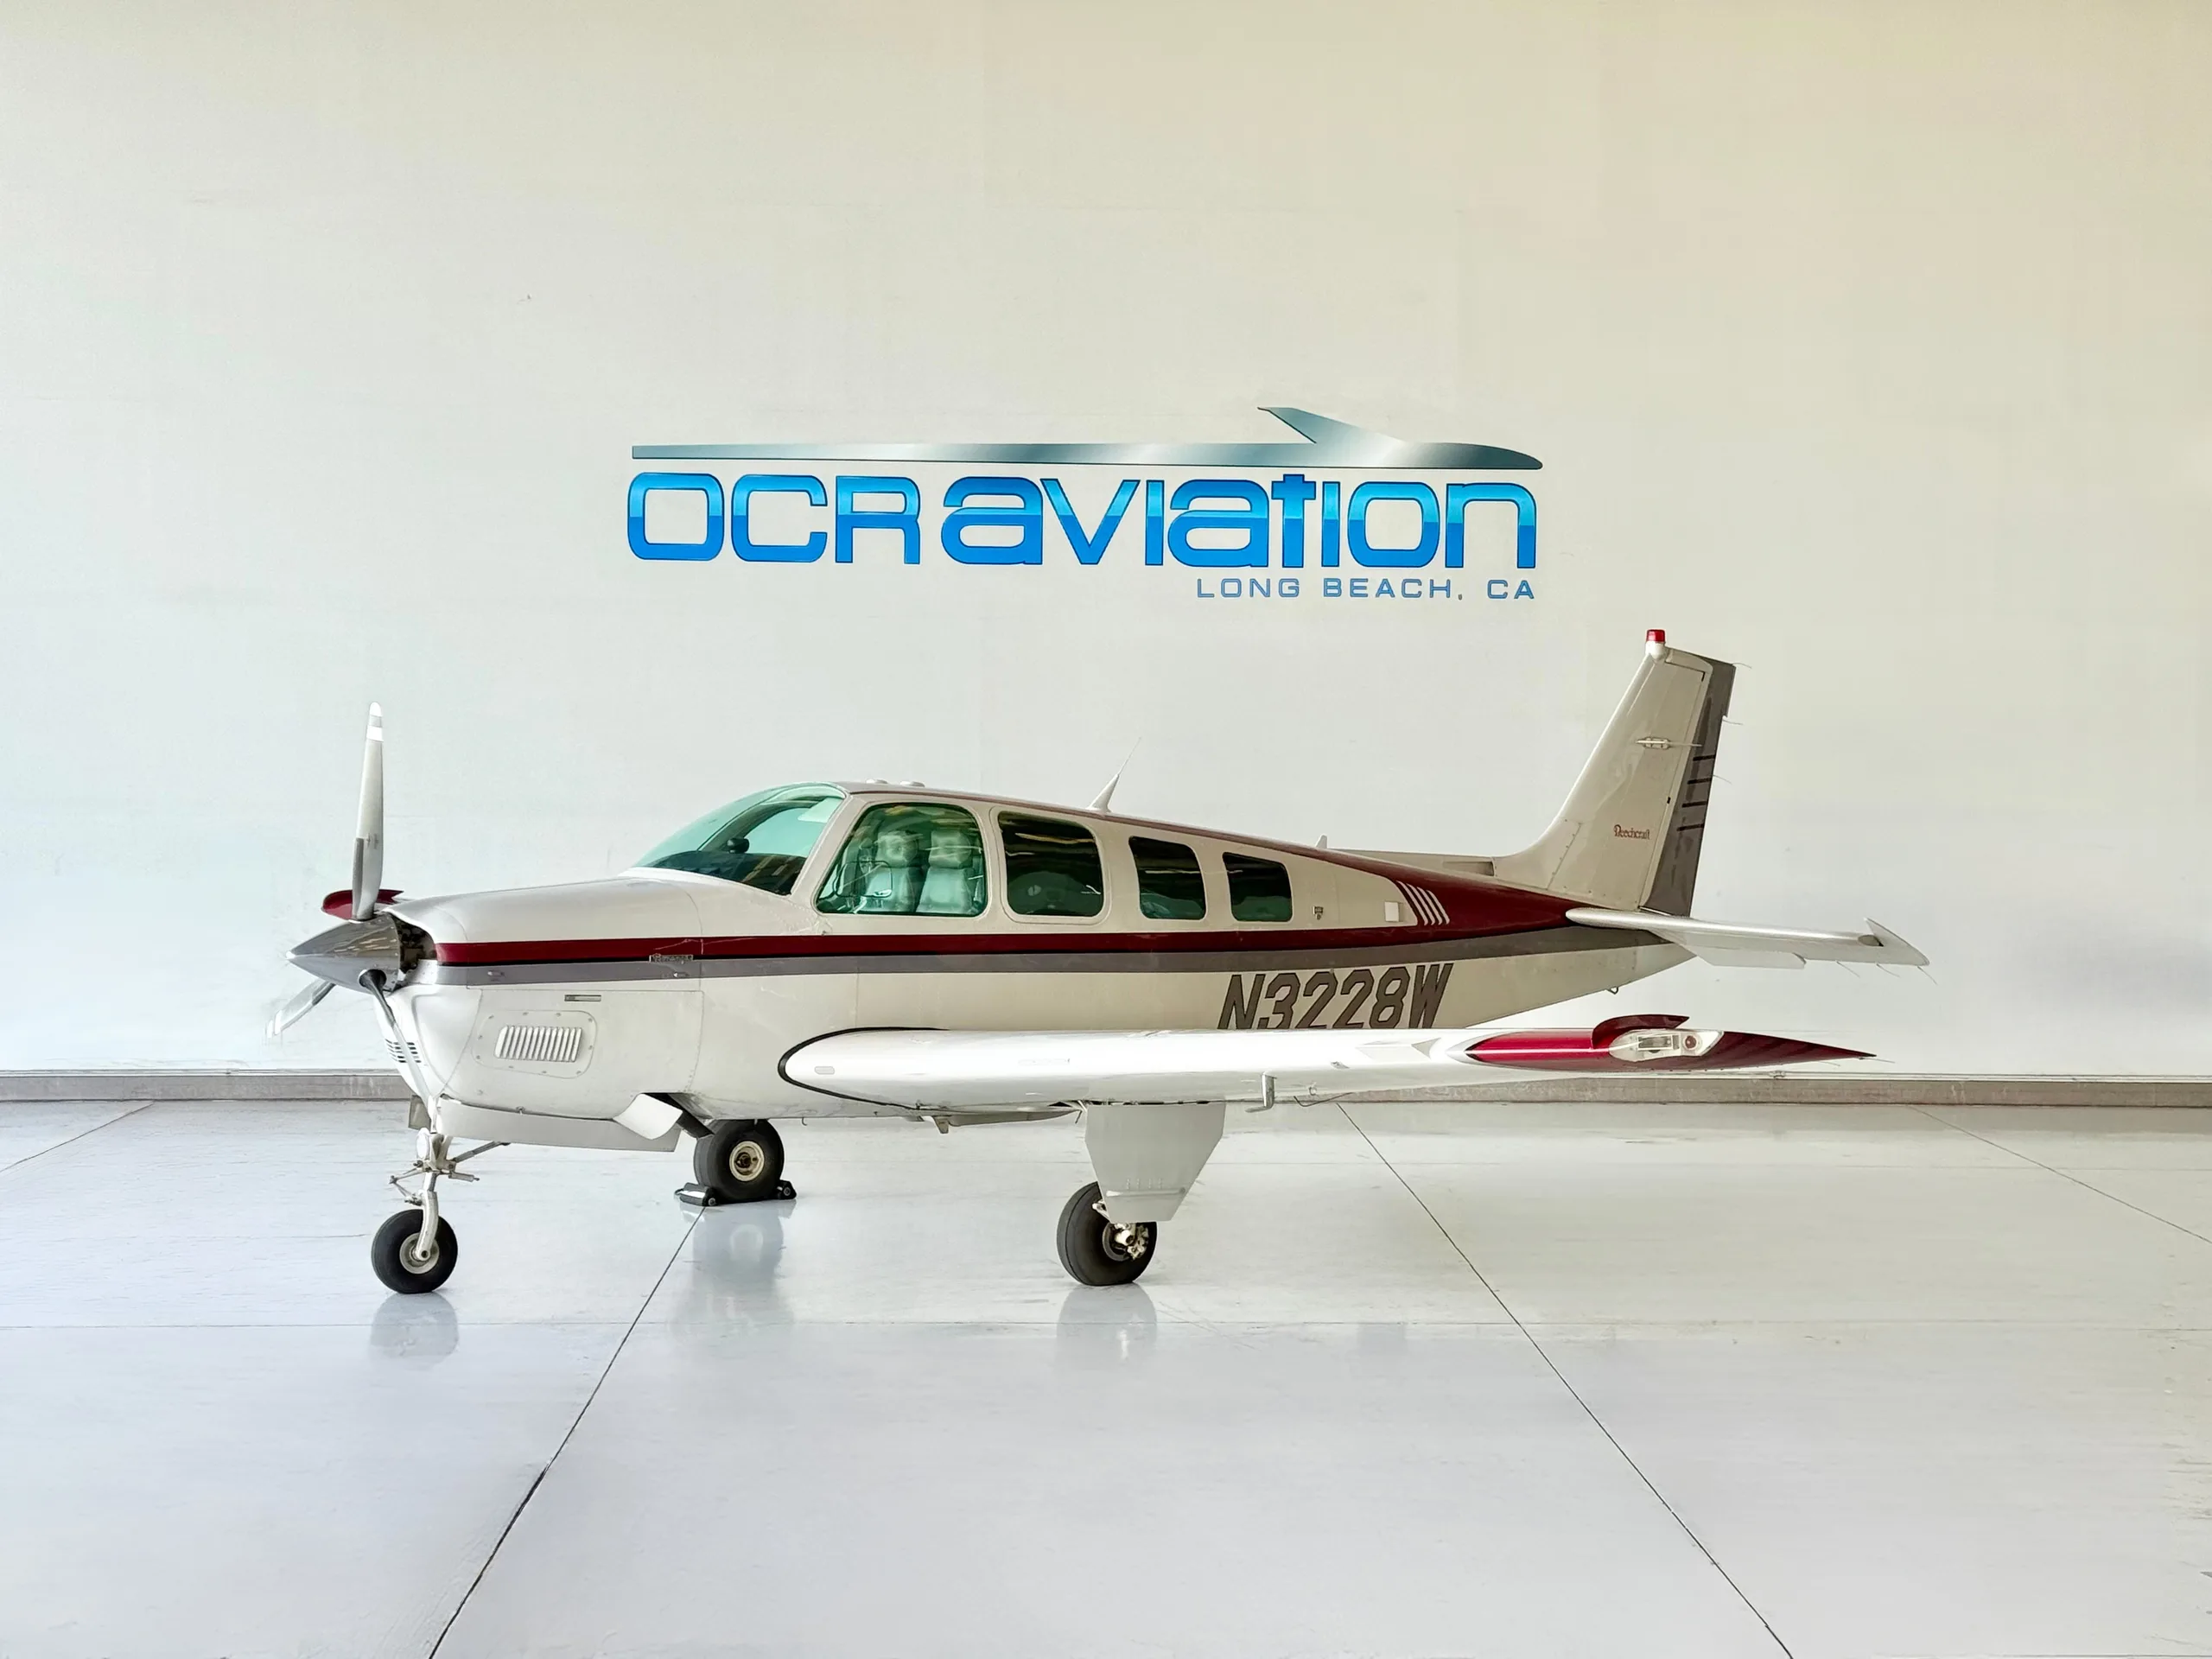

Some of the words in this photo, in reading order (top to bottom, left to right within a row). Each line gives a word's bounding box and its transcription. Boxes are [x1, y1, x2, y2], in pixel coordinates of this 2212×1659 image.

[626, 472, 921, 565] OCR
[940, 473, 1537, 569] aviation
[1197, 578, 1300, 597] LONG
[1487, 580, 1535, 599] CA
[1217, 963, 1454, 1029] N3228W
